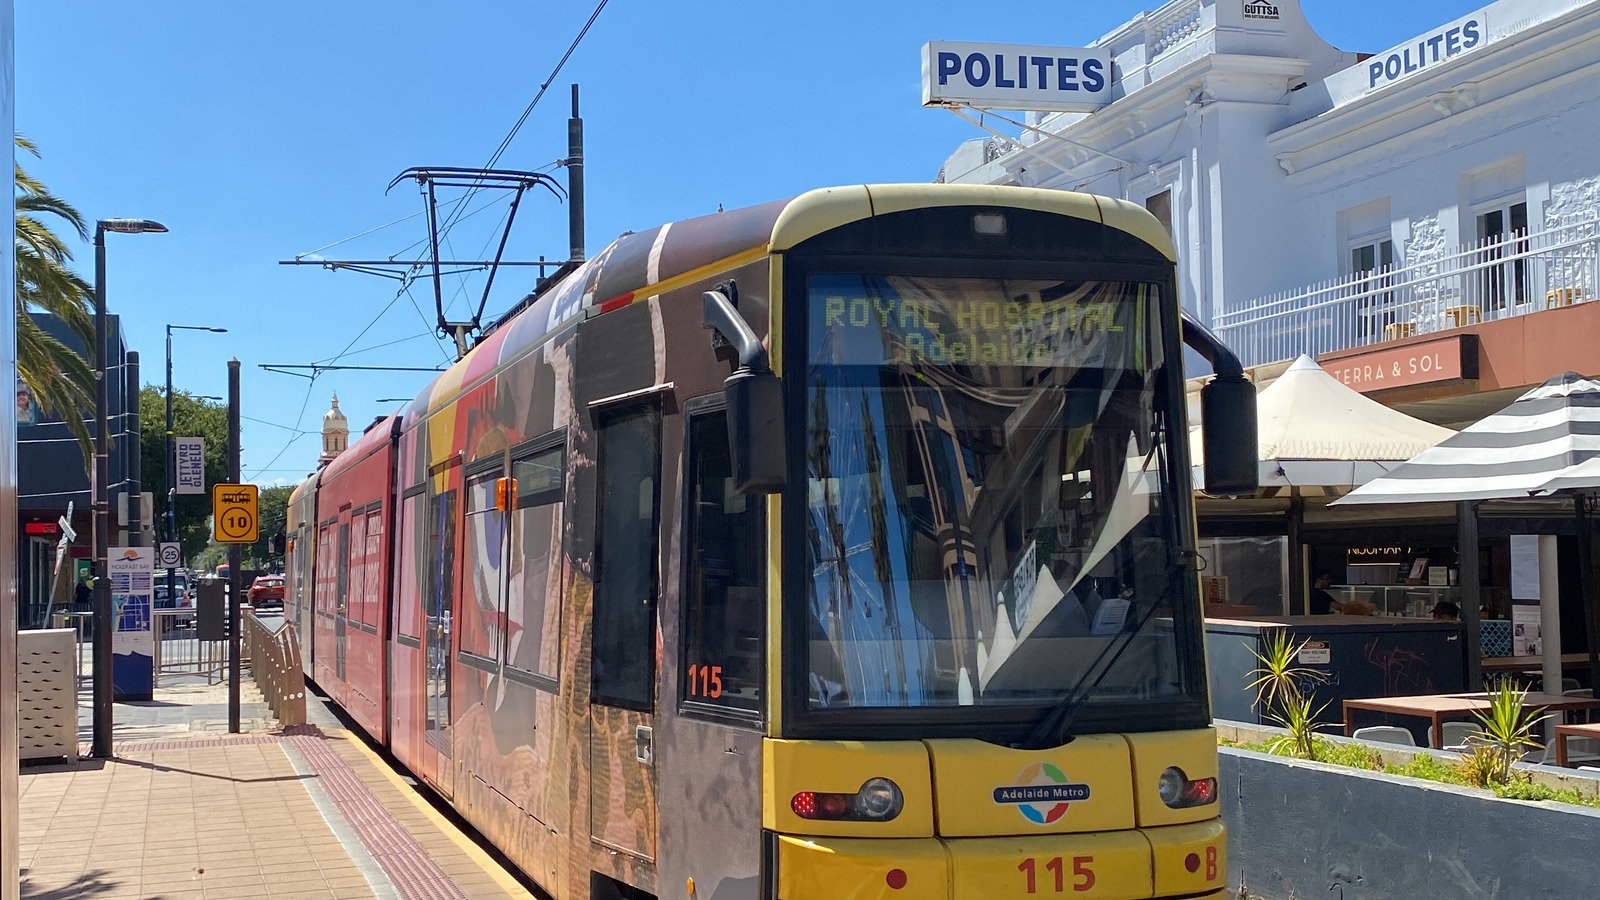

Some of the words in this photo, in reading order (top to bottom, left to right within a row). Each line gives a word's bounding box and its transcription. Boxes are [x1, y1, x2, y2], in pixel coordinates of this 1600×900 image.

[1245, 4, 1279, 15] GUTTSA
[1369, 20, 1479, 88] POLITES
[938, 52, 1105, 93] POLITES
[825, 297, 940, 329] ROYAL
[957, 301, 1124, 332] HOSPITAL
[905, 332, 1050, 363] Adelaide
[1334, 363, 1384, 385] TERRA
[1392, 361, 1401, 377] &
[1409, 353, 1443, 375] SOL
[189, 444, 202, 487] GLENELG
[227, 516, 247, 528] 10
[165, 551, 177, 560] 25
[688, 664, 722, 698] 115
[1002, 788, 1050, 799] Adelaide
[1053, 788, 1084, 798] Metro
[1018, 856, 1096, 893] 115
[1206, 846, 1217, 881] B
